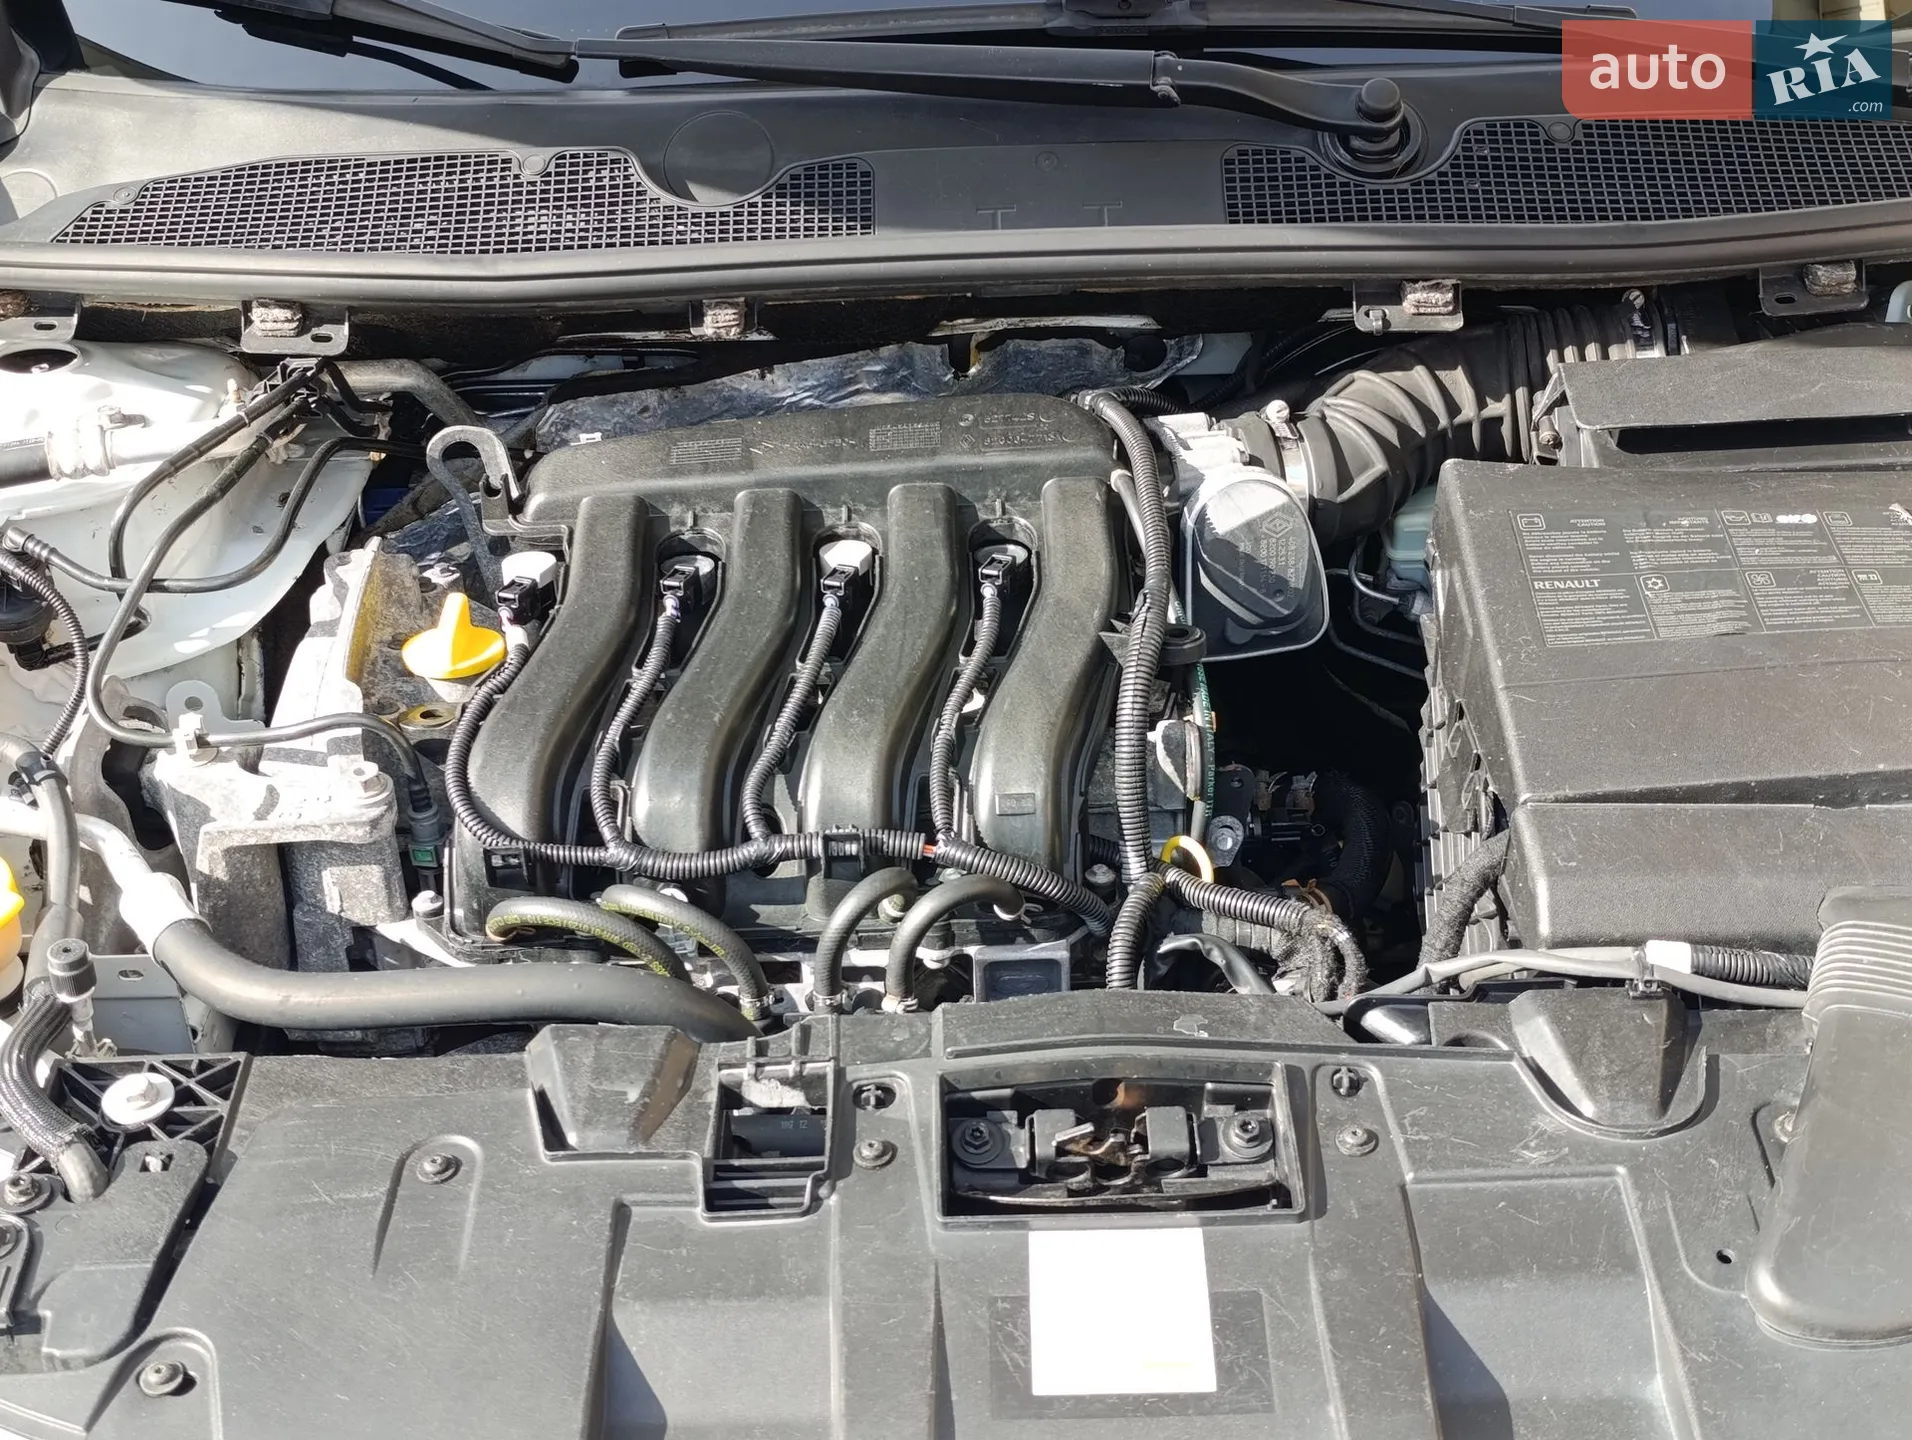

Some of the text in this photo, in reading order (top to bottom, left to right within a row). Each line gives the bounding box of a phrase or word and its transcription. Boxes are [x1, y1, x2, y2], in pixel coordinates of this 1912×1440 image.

[1533, 579, 1600, 590] RENAULT
[1204, 723, 1216, 753] ITALY
[1207, 764, 1216, 797] Parker
